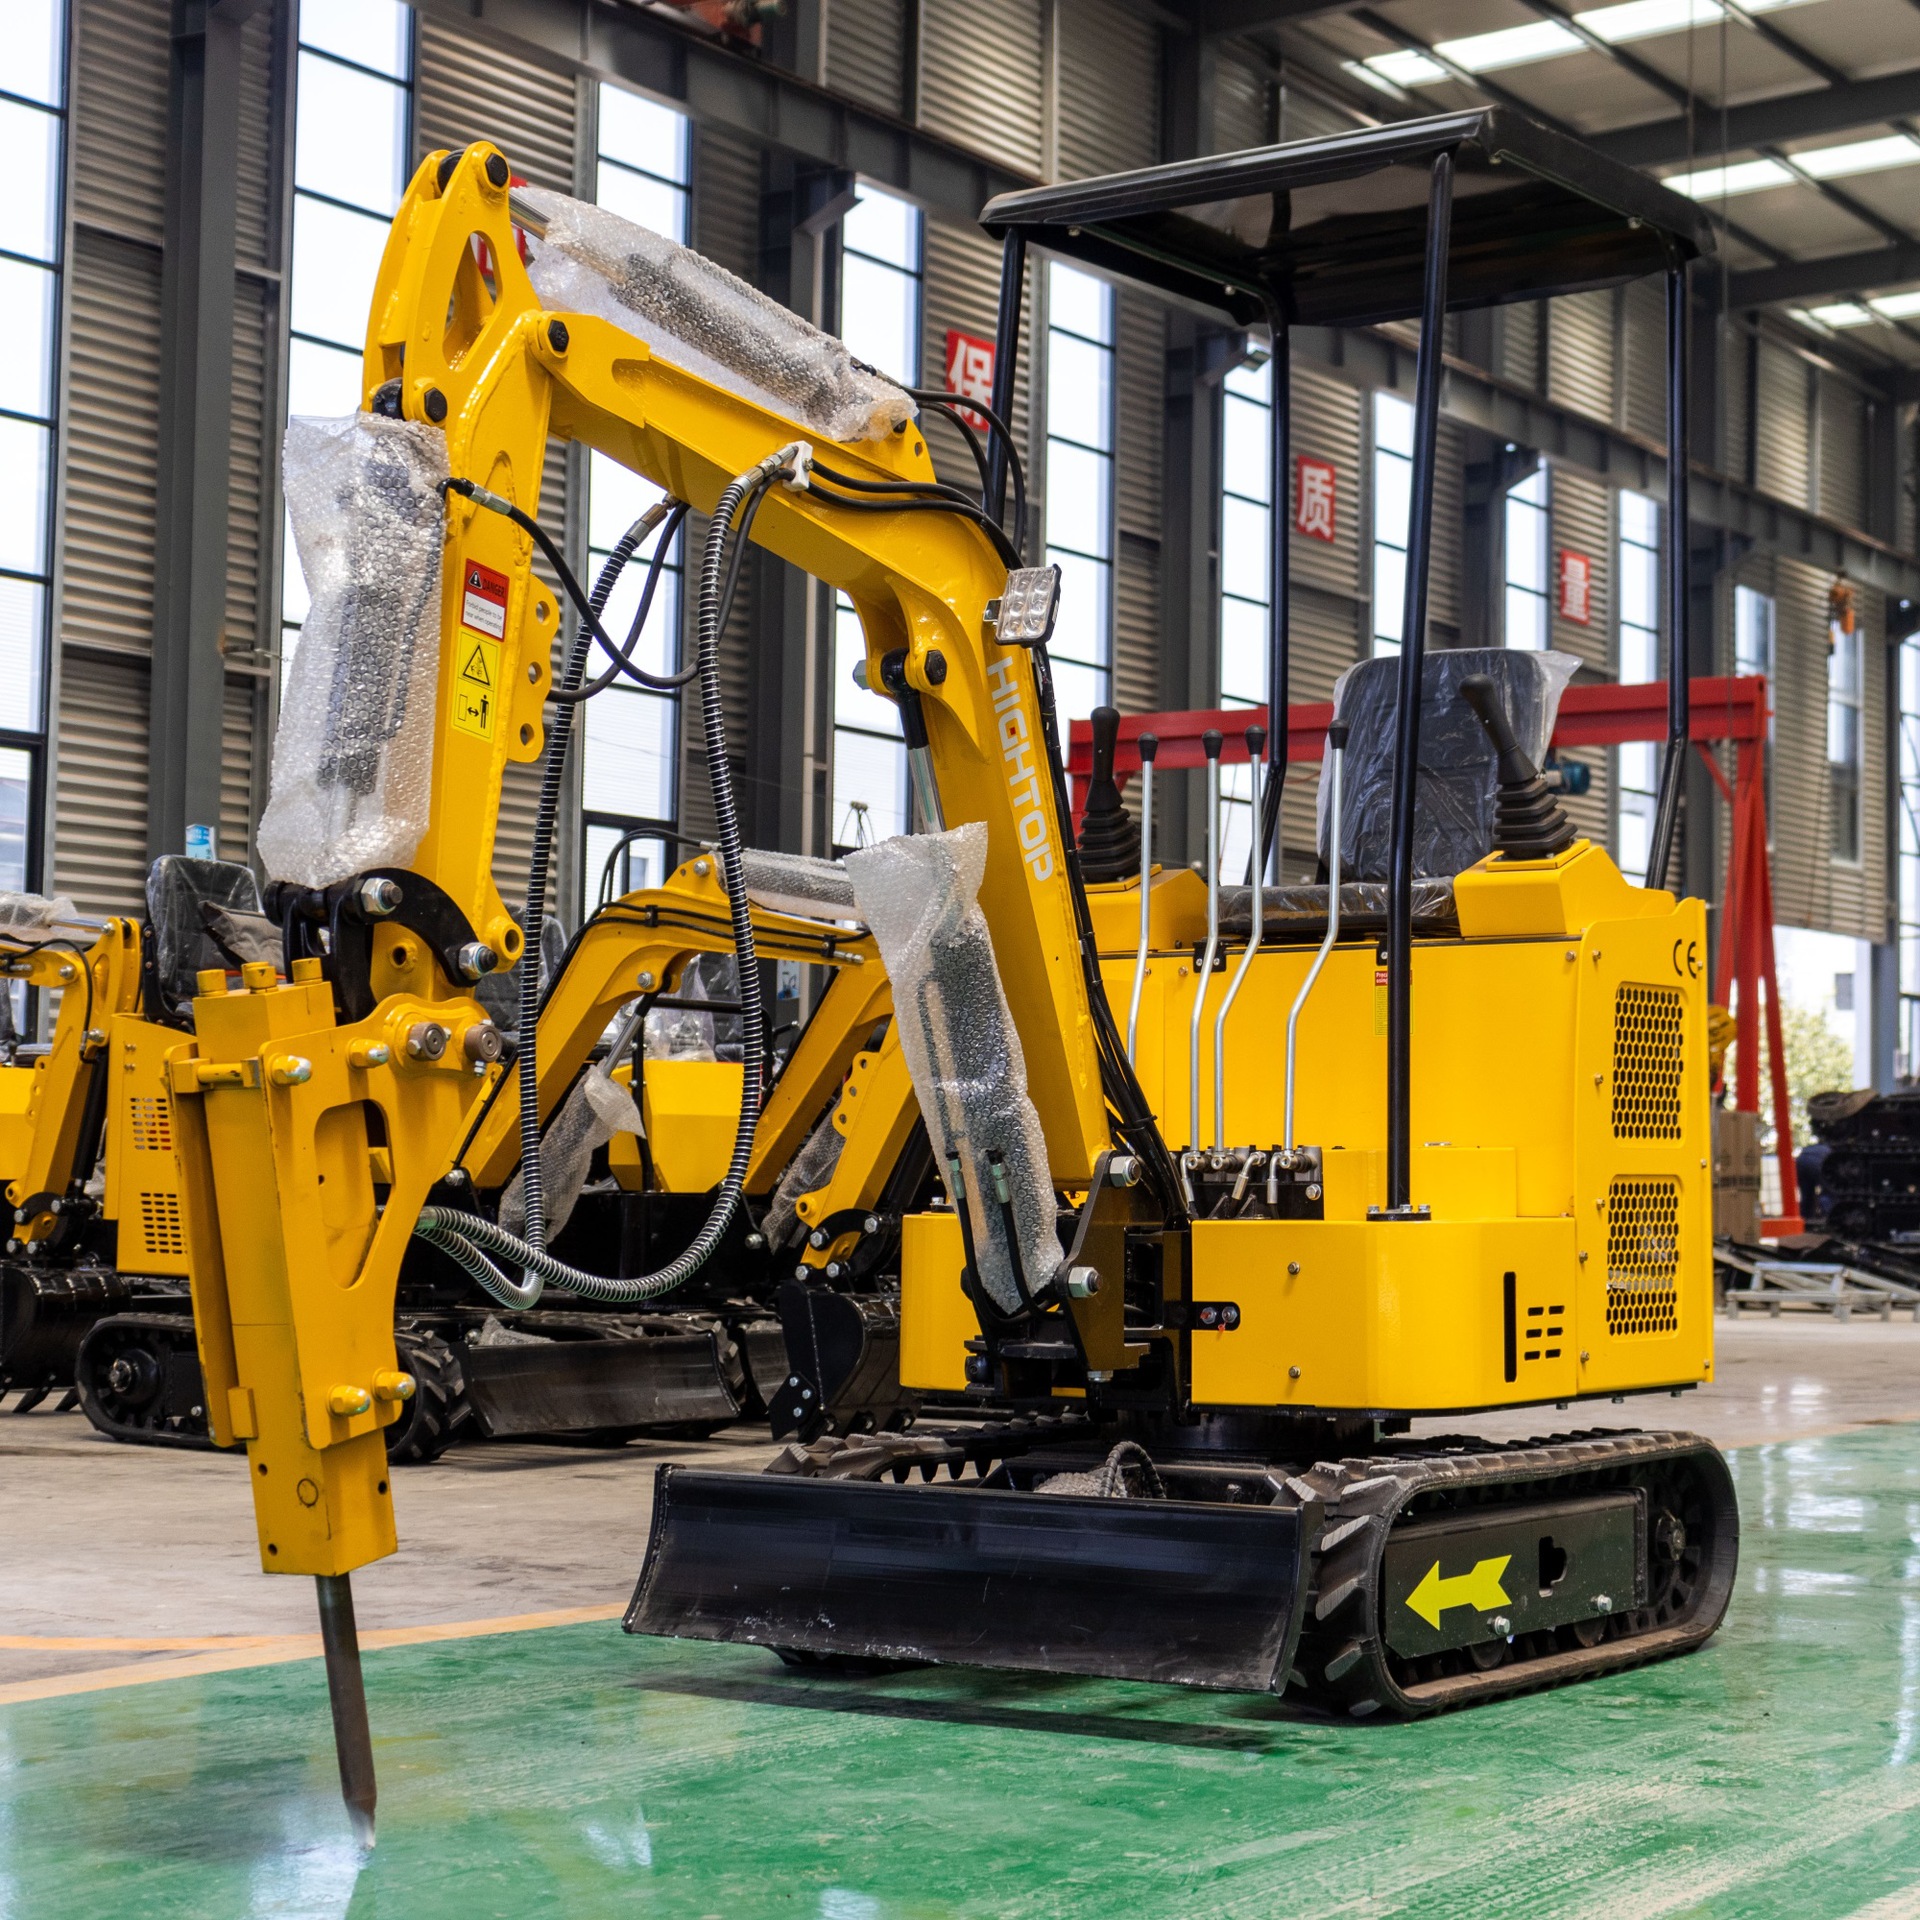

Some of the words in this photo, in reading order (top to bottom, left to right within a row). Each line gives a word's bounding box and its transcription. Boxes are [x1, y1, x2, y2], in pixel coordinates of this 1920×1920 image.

[949, 337, 993, 426] 保
[1299, 465, 1333, 539] 质
[482, 578, 505, 598] DANGER
[1561, 557, 1588, 621] 量
[987, 655, 1054, 882] HIGHTOP
[1673, 938, 1697, 979] CE
